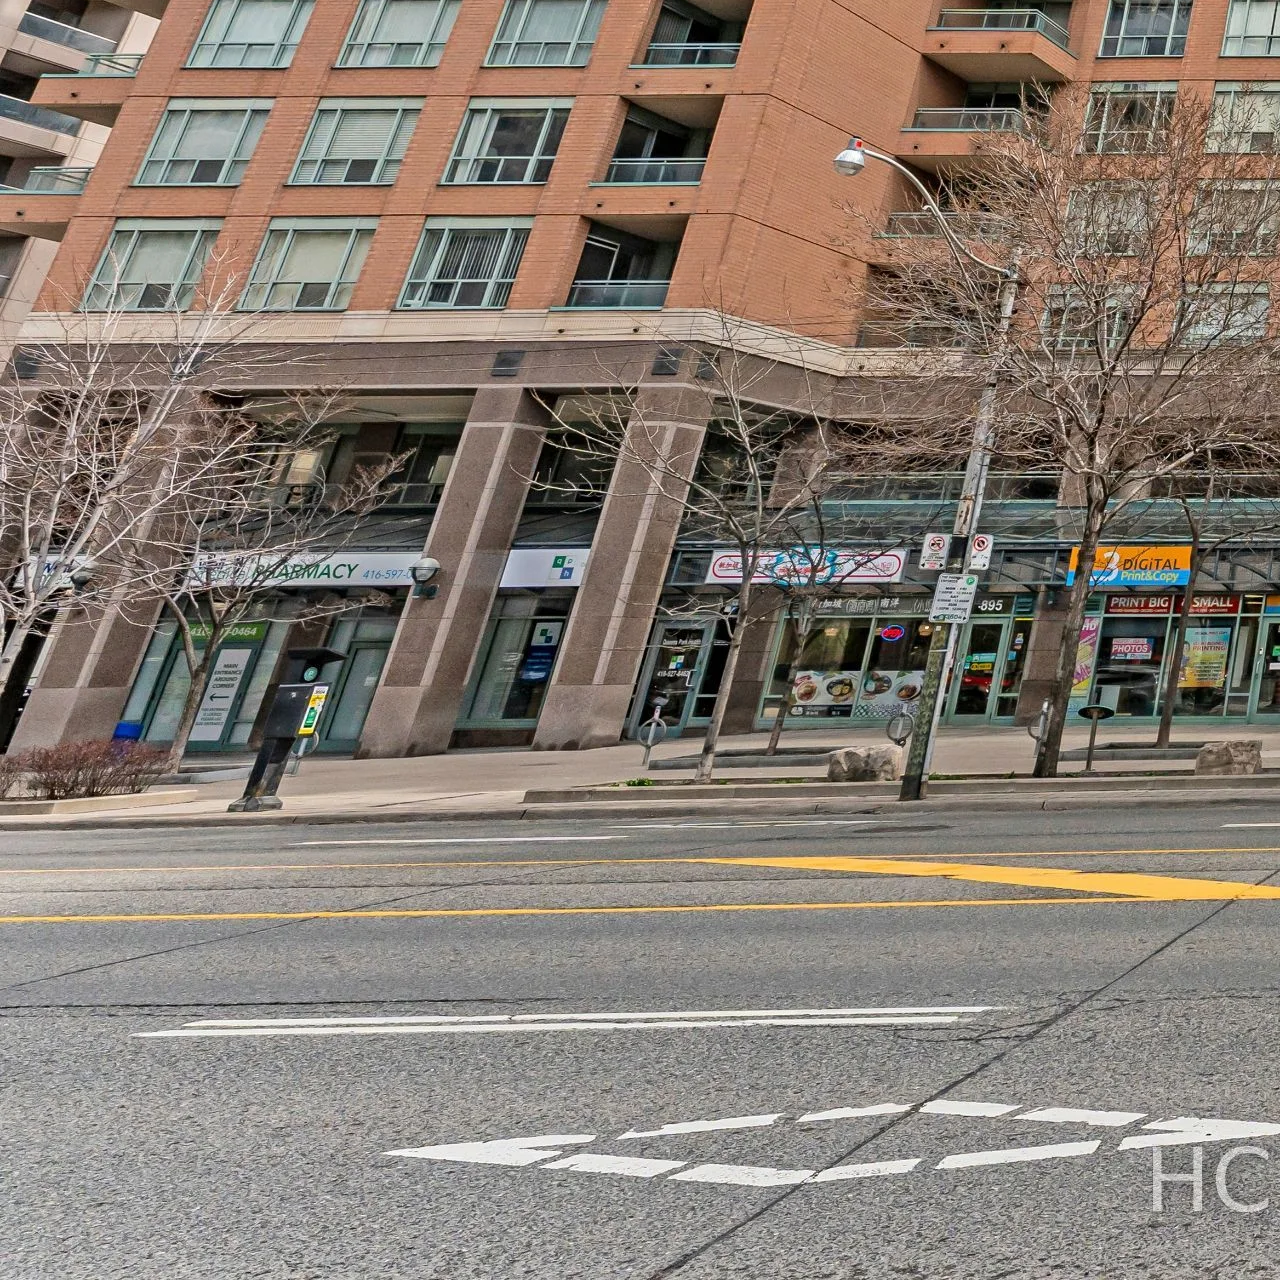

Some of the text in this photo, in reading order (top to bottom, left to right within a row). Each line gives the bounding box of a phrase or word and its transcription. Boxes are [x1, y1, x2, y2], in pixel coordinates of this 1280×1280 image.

[362, 569, 413, 579] 416-597-0
[1121, 571, 1179, 583] Print&Copy
[1110, 597, 1146, 608] PRINT
[1148, 597, 1169, 608] BIG
[1191, 596, 1234, 608] SMALL
[189, 626, 257, 637] 416-7-0464
[1112, 644, 1149, 653] PHOTOS
